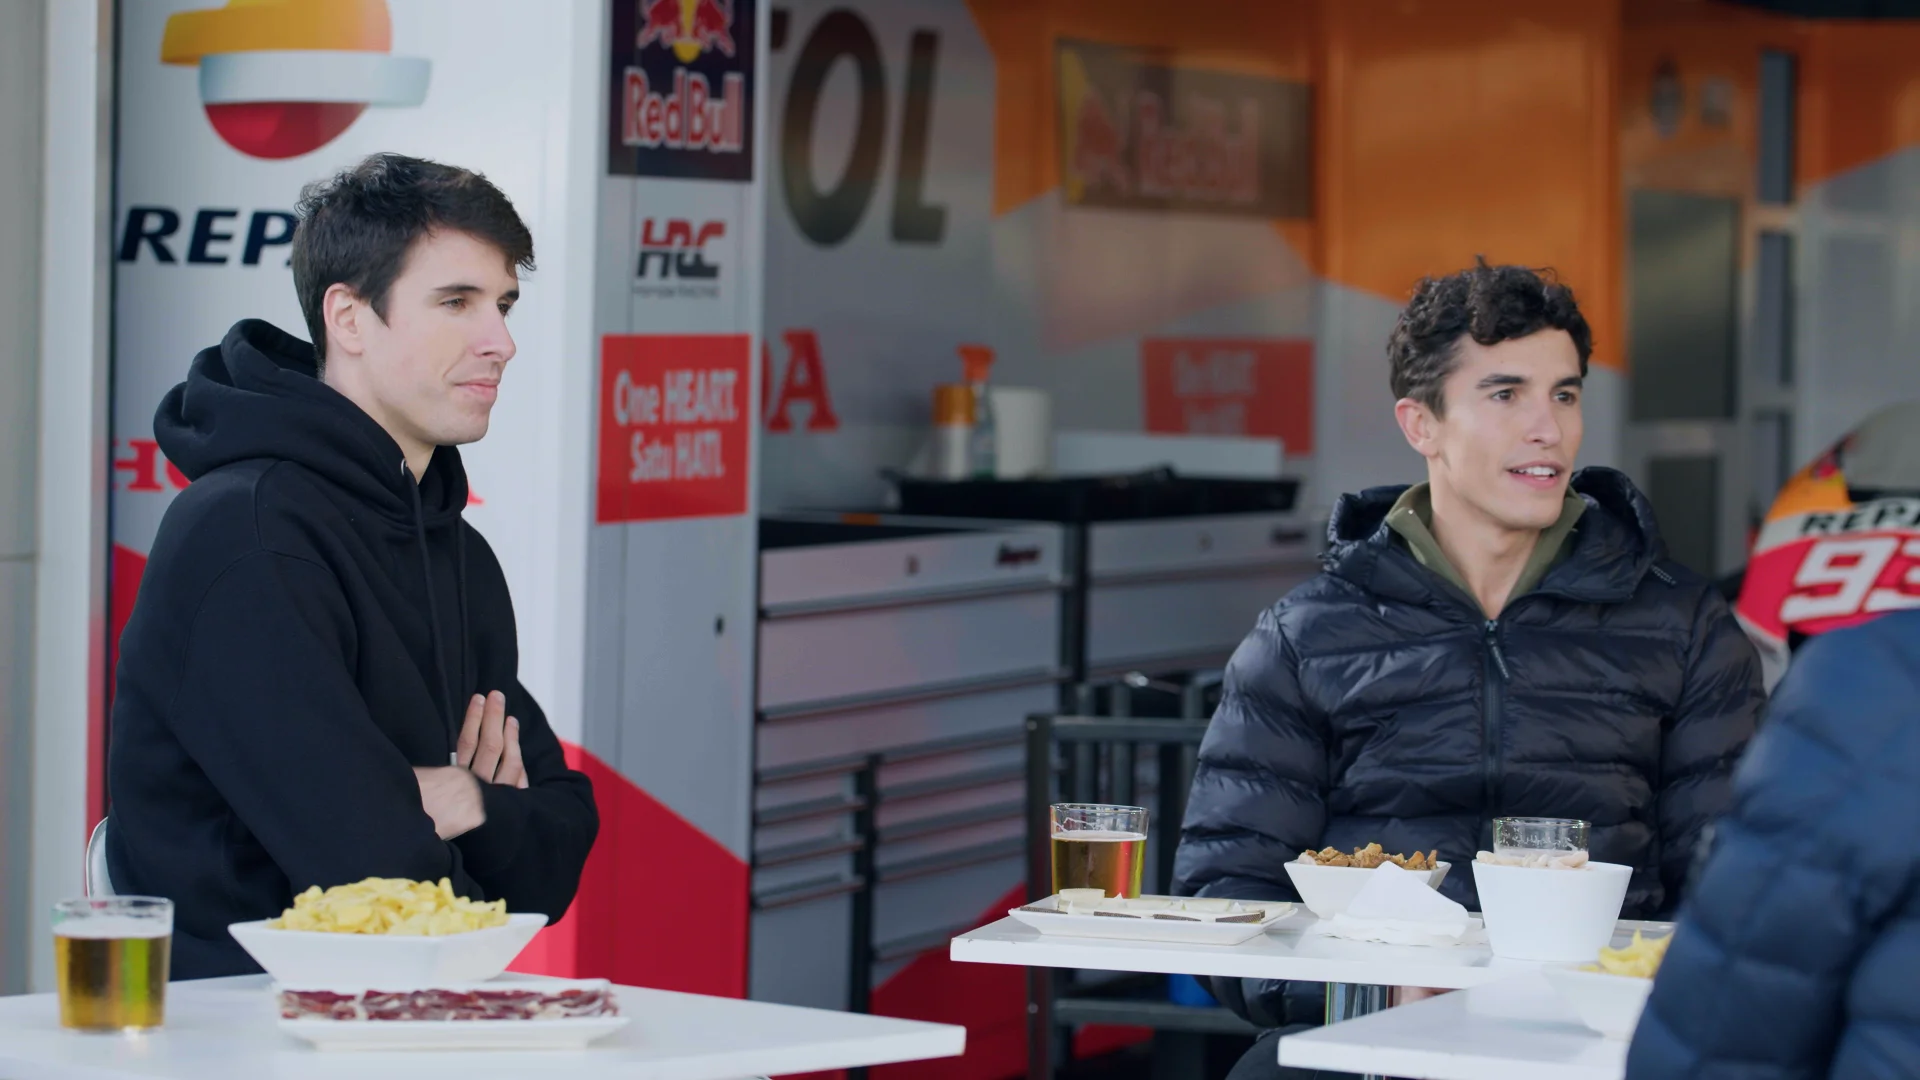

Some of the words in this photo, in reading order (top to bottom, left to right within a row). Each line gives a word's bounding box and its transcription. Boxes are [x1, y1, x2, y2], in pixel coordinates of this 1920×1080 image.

[622, 66, 687, 149] Red
[687, 71, 744, 152] Bull
[771, 7, 949, 249] OL
[118, 206, 297, 266] REP
[637, 217, 726, 279] HRC
[614, 369, 660, 426] One
[630, 431, 672, 483] Satu
[1801, 499, 1920, 534] REP
